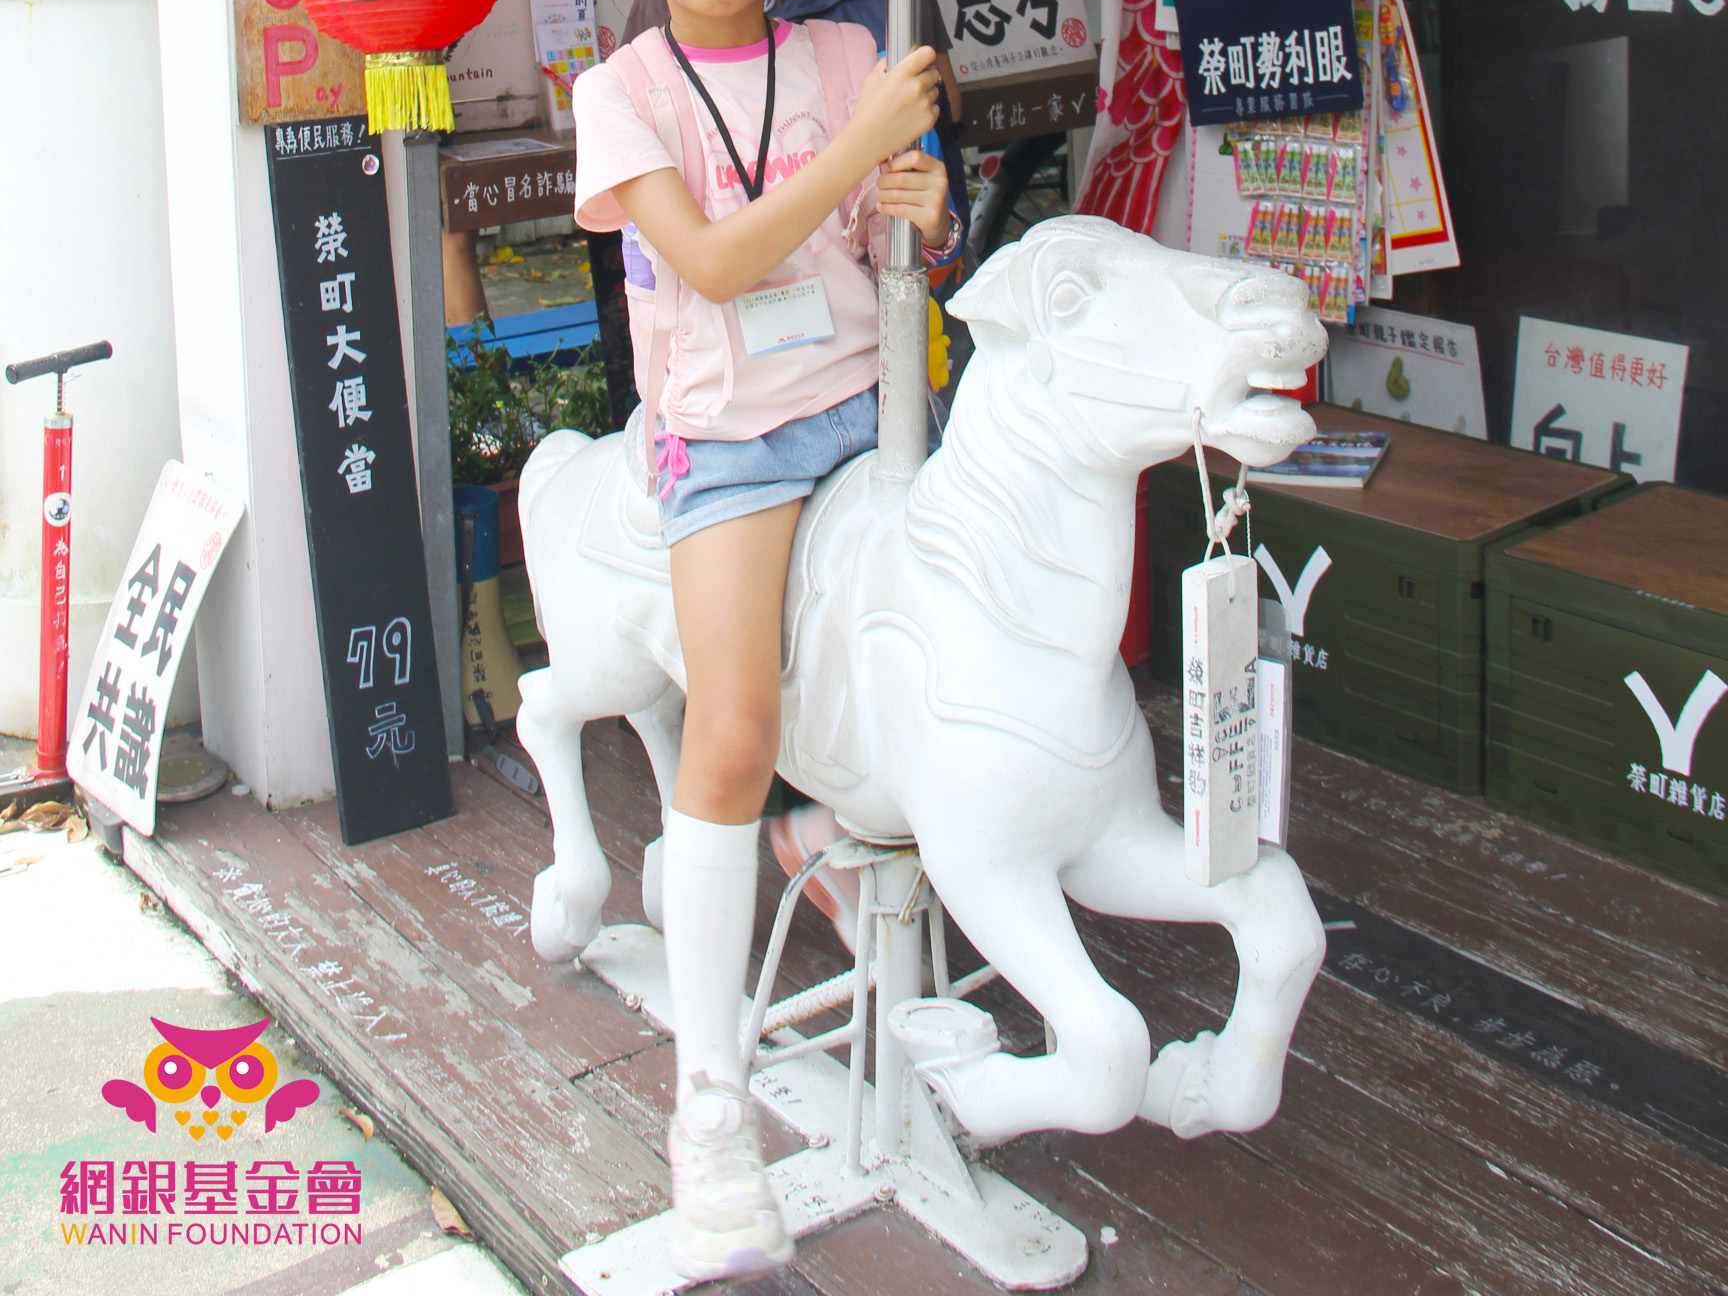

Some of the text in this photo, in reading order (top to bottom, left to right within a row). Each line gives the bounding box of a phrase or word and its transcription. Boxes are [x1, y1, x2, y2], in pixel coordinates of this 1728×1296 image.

[447, 67, 493, 82] untain
[1198, 24, 1353, 96] 榮町勢利眼
[987, 92, 1064, 130] 僅此一家
[313, 211, 376, 494] 榮町大便當
[1544, 344, 1669, 390] 台灣值得更好
[1289, 638, 1330, 671] 雜貨店
[1626, 762, 1727, 821] 榮町雜貨店
